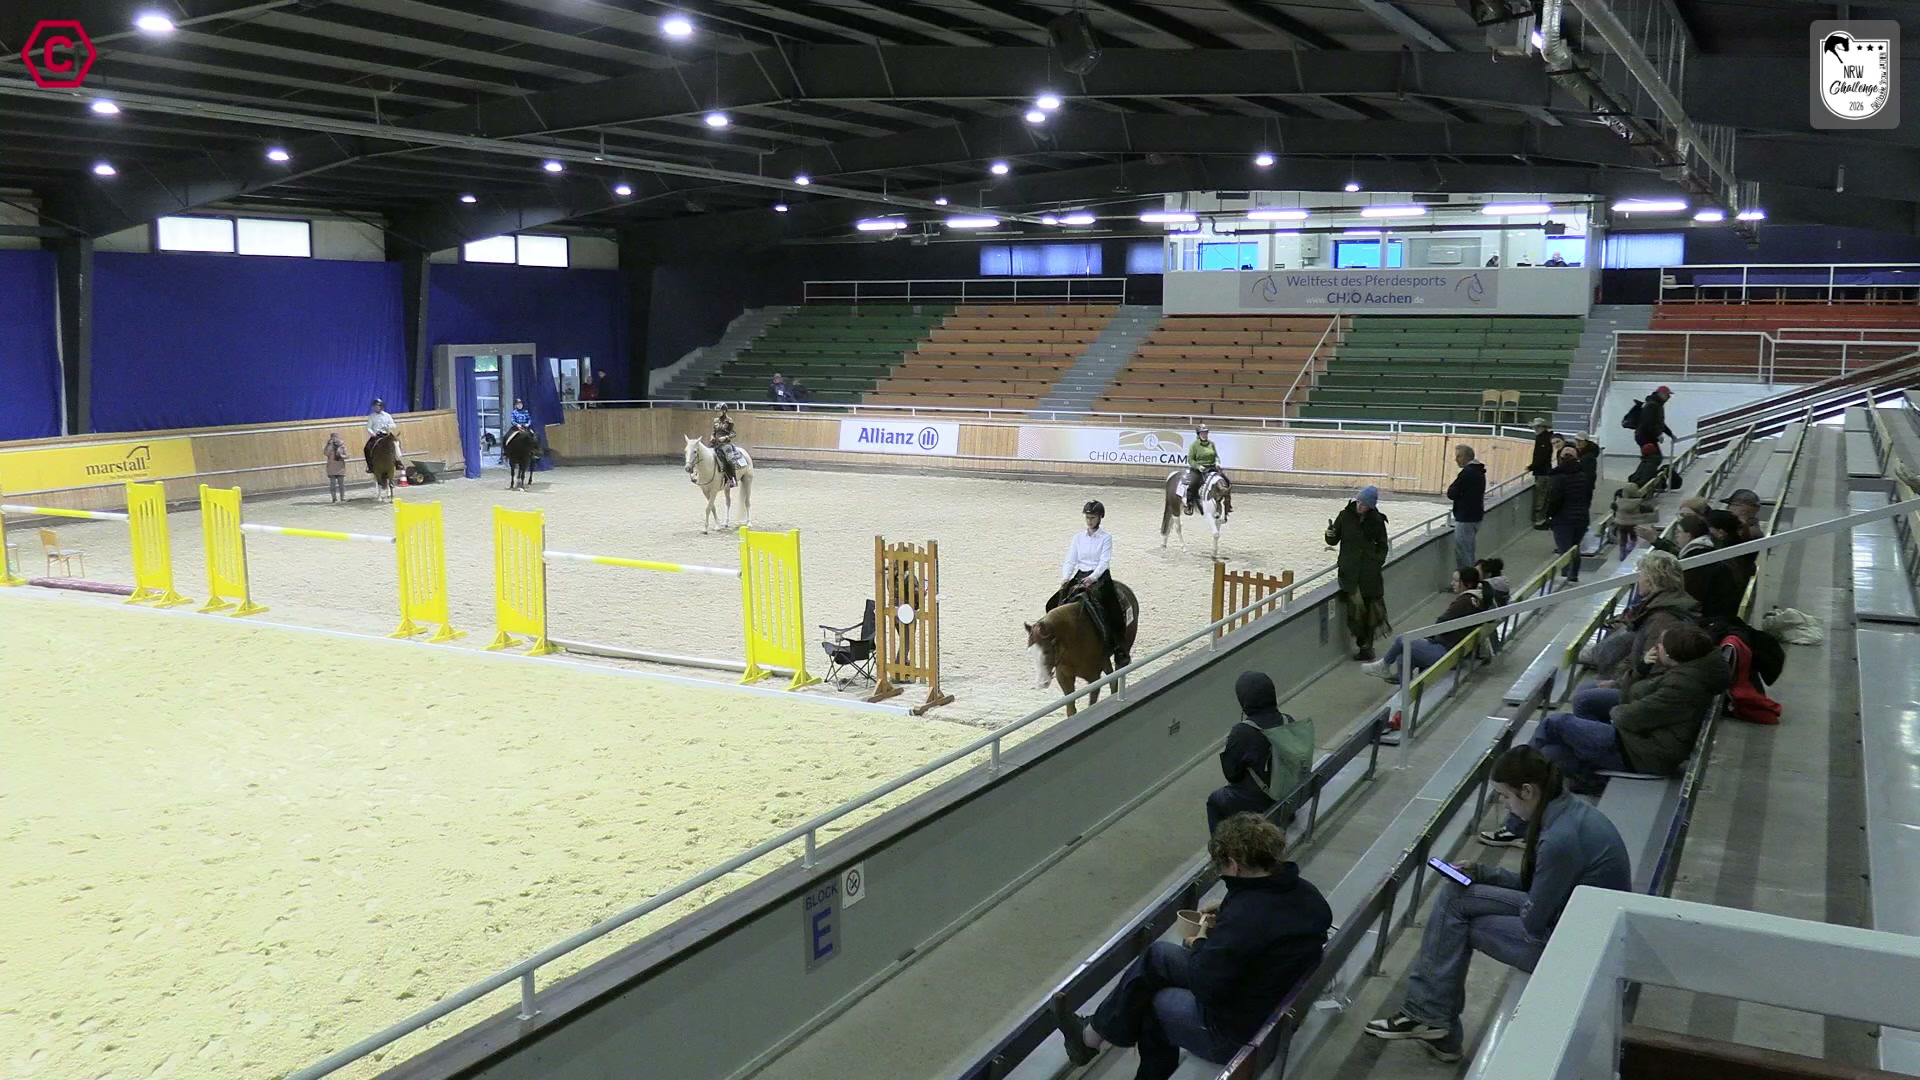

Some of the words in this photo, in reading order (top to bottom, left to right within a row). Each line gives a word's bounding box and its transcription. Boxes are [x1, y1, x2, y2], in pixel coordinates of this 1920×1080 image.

[1286, 275, 1338, 287] Weltfest
[1340, 275, 1362, 287] des
[1365, 275, 1447, 289] Pferdesports
[858, 427, 914, 445] Allianz
[86, 457, 146, 476] marstall
[1089, 450, 1118, 462] CHIO
[1119, 453, 1158, 464] Aachen
[1159, 454, 1188, 465] CAM
[805, 884, 838, 911] BLOCK
[812, 906, 833, 961] E
